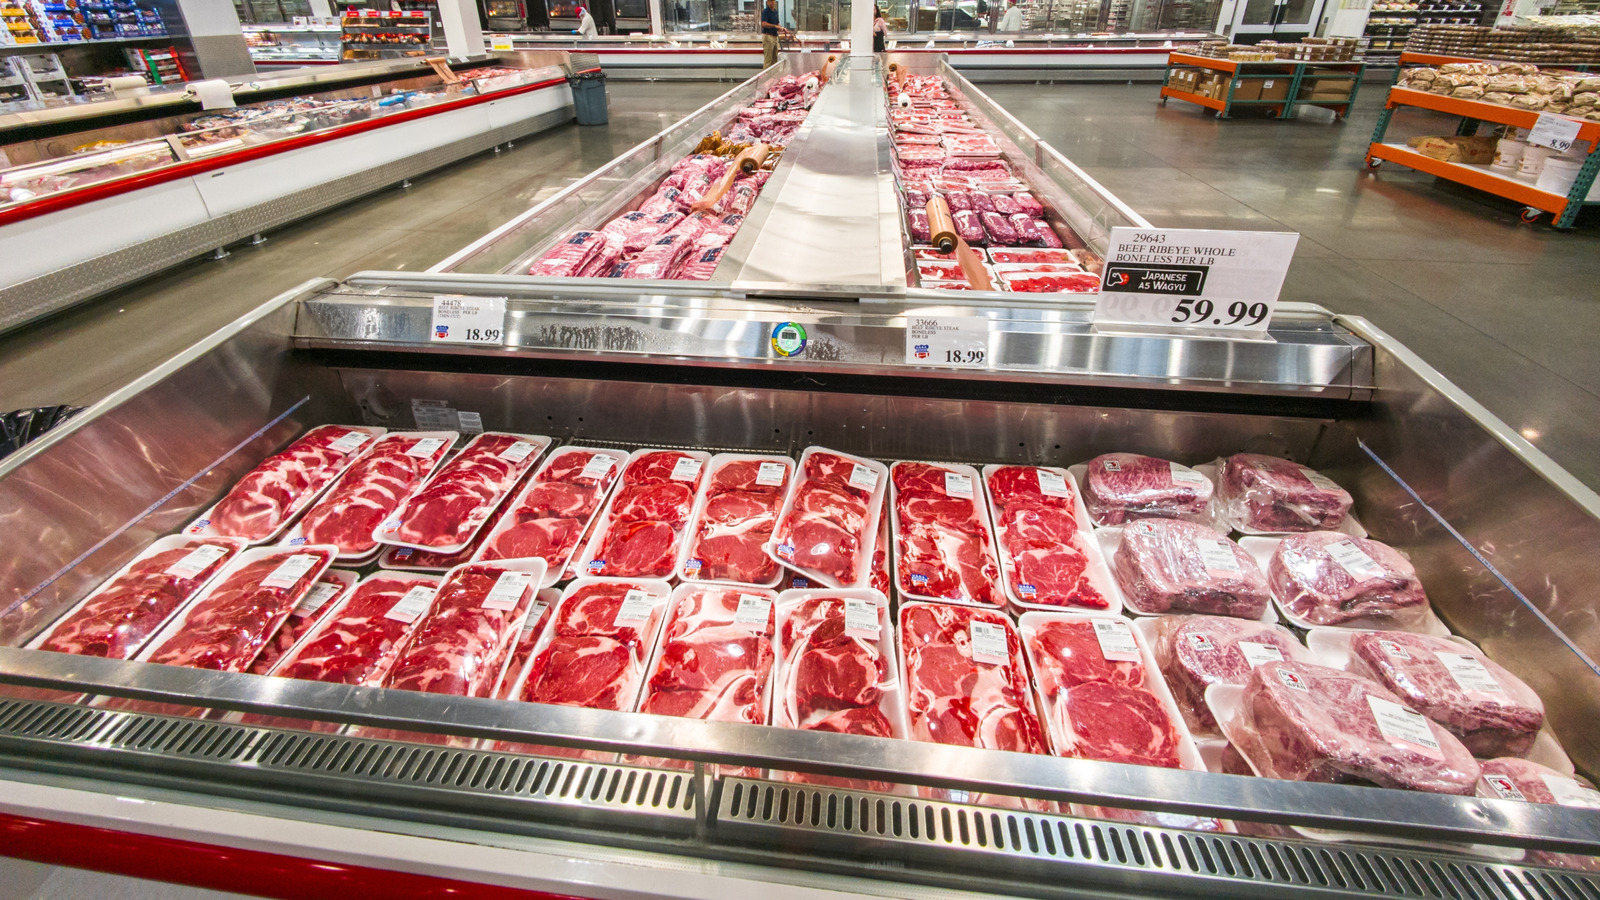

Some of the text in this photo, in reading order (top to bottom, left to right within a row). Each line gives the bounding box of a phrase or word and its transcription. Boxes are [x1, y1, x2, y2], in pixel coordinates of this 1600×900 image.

[1550, 139, 1570, 150] 8.99
[1133, 233, 1166, 243] 29643
[1118, 244, 1236, 257] BEEF RIBEYE WHOLE
[1116, 253, 1215, 265] BONELESS PER LB
[1141, 270, 1188, 282] JAPANESE
[1138, 281, 1187, 292] A5 WAGYU
[1171, 299, 1269, 327] 59.99
[915, 319, 938, 327] 33666
[466, 328, 500, 341] 18.99
[945, 350, 985, 363] 18.99
